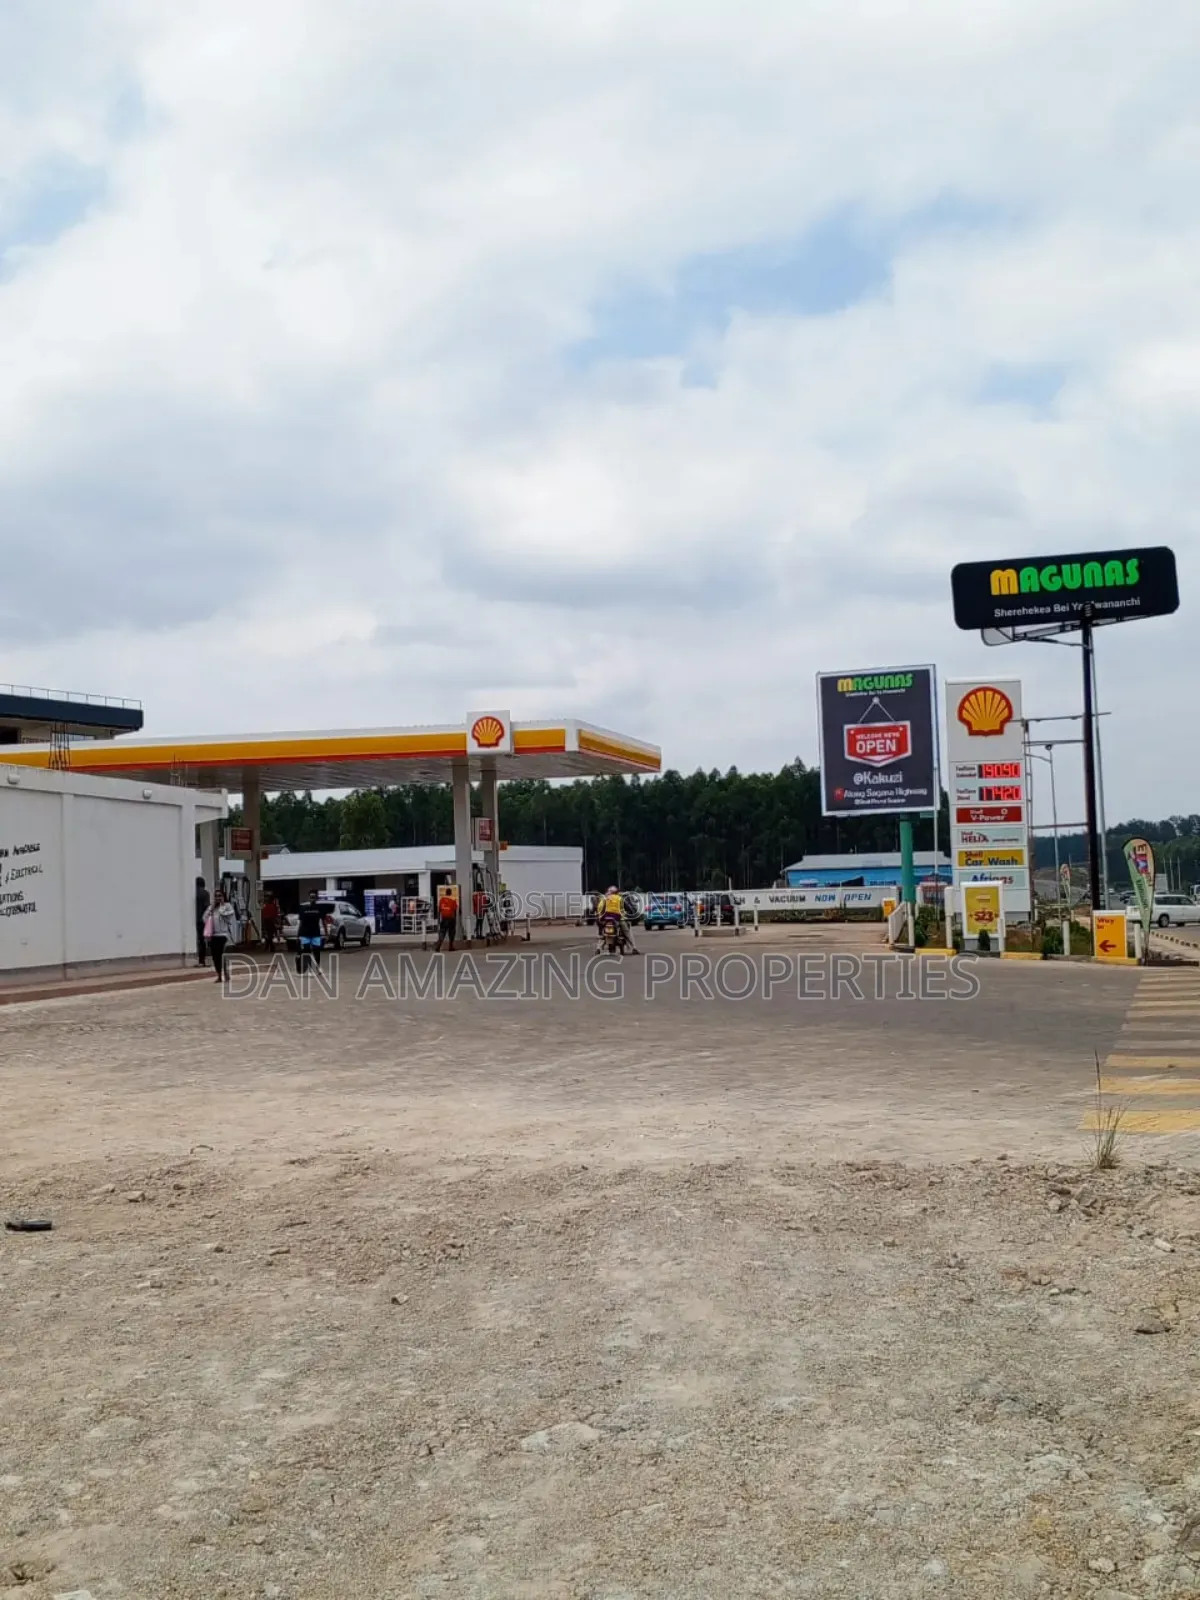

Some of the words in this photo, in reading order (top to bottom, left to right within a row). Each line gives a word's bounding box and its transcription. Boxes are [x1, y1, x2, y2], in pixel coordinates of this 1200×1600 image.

[990, 558, 1140, 595] MAGUNAS
[994, 605, 1051, 618] Sherehekea
[1053, 603, 1070, 613] Bei
[1090, 597, 1141, 609] wananchi
[837, 673, 913, 692] MAGUNAS
[856, 739, 896, 754] OPEN
[853, 770, 903, 785] @Kakuzi
[961, 835, 989, 843] HELIX
[964, 850, 984, 858] Shell
[964, 858, 983, 867] Car
[988, 856, 1018, 866] Wash
[768, 895, 806, 905] VACUUM
[814, 893, 836, 902] NOW
[844, 892, 871, 902] OPEN
